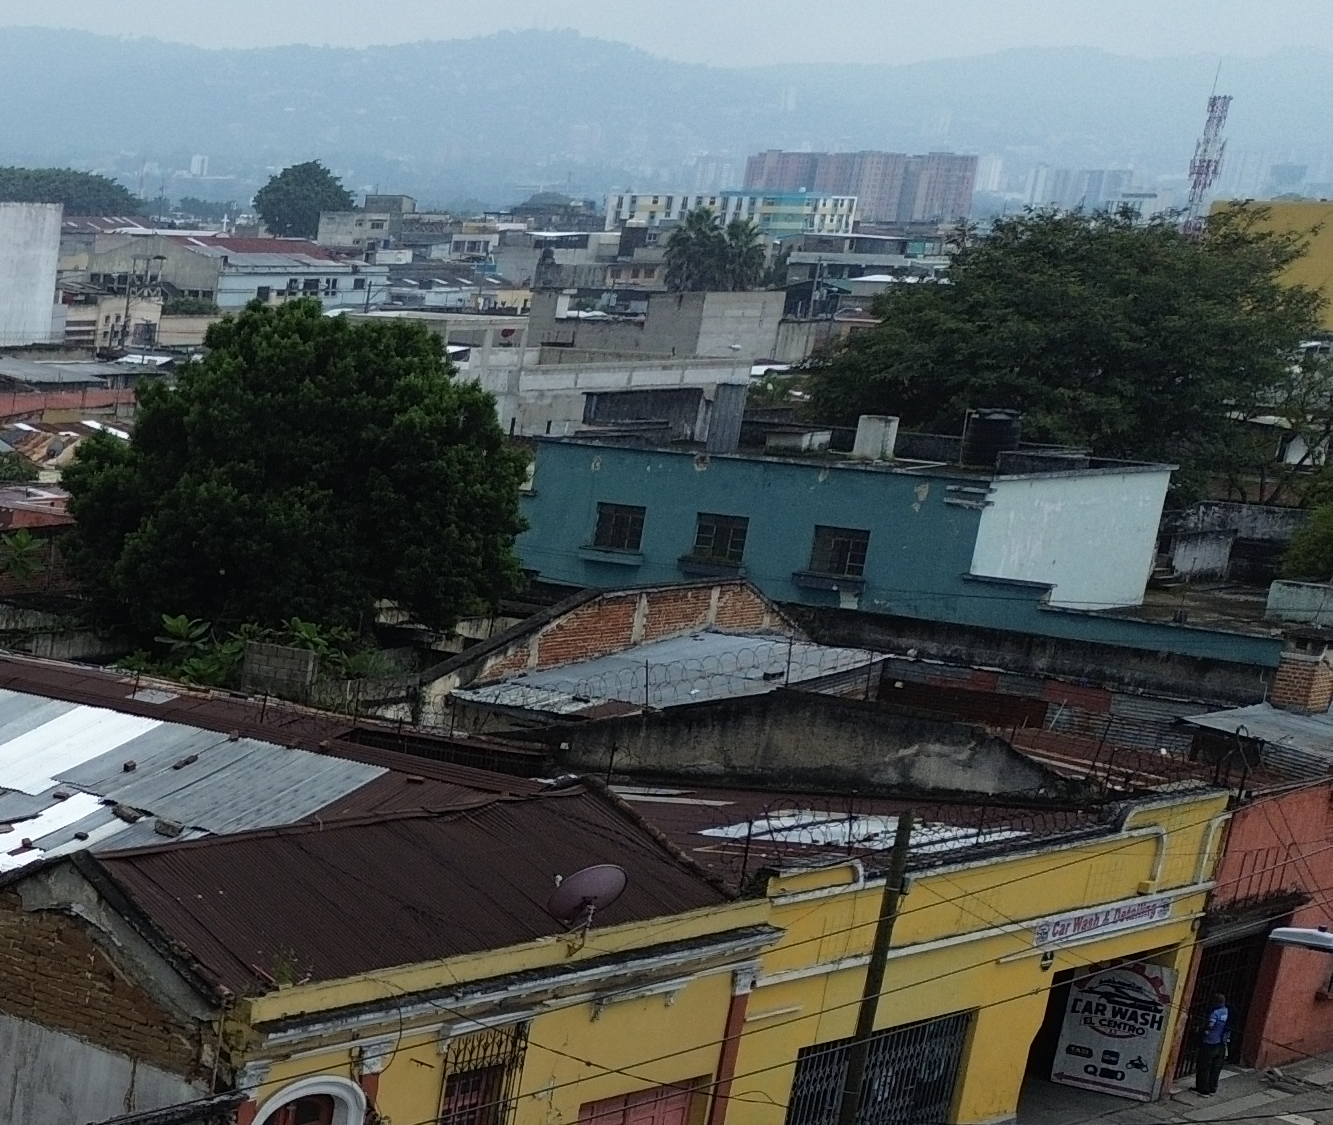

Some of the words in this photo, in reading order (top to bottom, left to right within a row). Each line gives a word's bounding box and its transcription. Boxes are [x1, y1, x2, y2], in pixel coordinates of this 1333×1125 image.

[1052, 920, 1071, 938] Car
[1072, 913, 1100, 933] Wash
[1070, 998, 1107, 1016] CAR
[1111, 1005, 1164, 1031] WASH
[1083, 1016, 1095, 1026] EL
[1098, 1018, 1146, 1035] CENTRO
